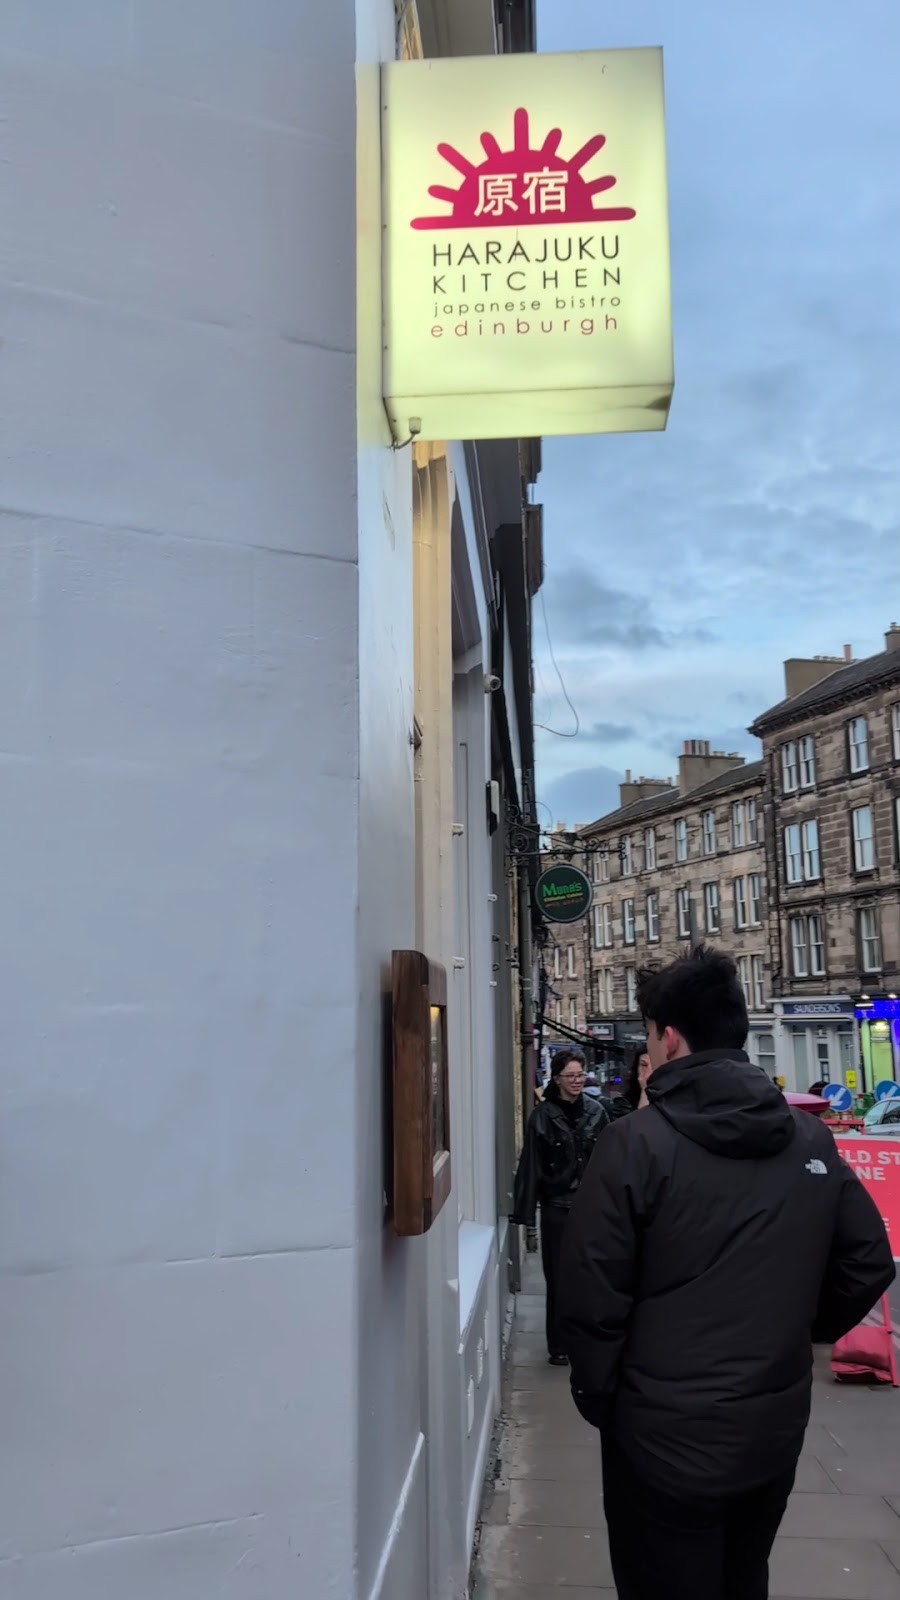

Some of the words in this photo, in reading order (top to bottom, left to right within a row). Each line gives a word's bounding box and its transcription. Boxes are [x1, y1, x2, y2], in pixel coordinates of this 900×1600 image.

[473, 166, 569, 217] 原宿
[432, 235, 619, 267] HARAJUKU
[432, 267, 621, 294] KITCHEN
[433, 300, 541, 318] japanese
[555, 295, 621, 310] bistro
[430, 314, 618, 338] edinburgh
